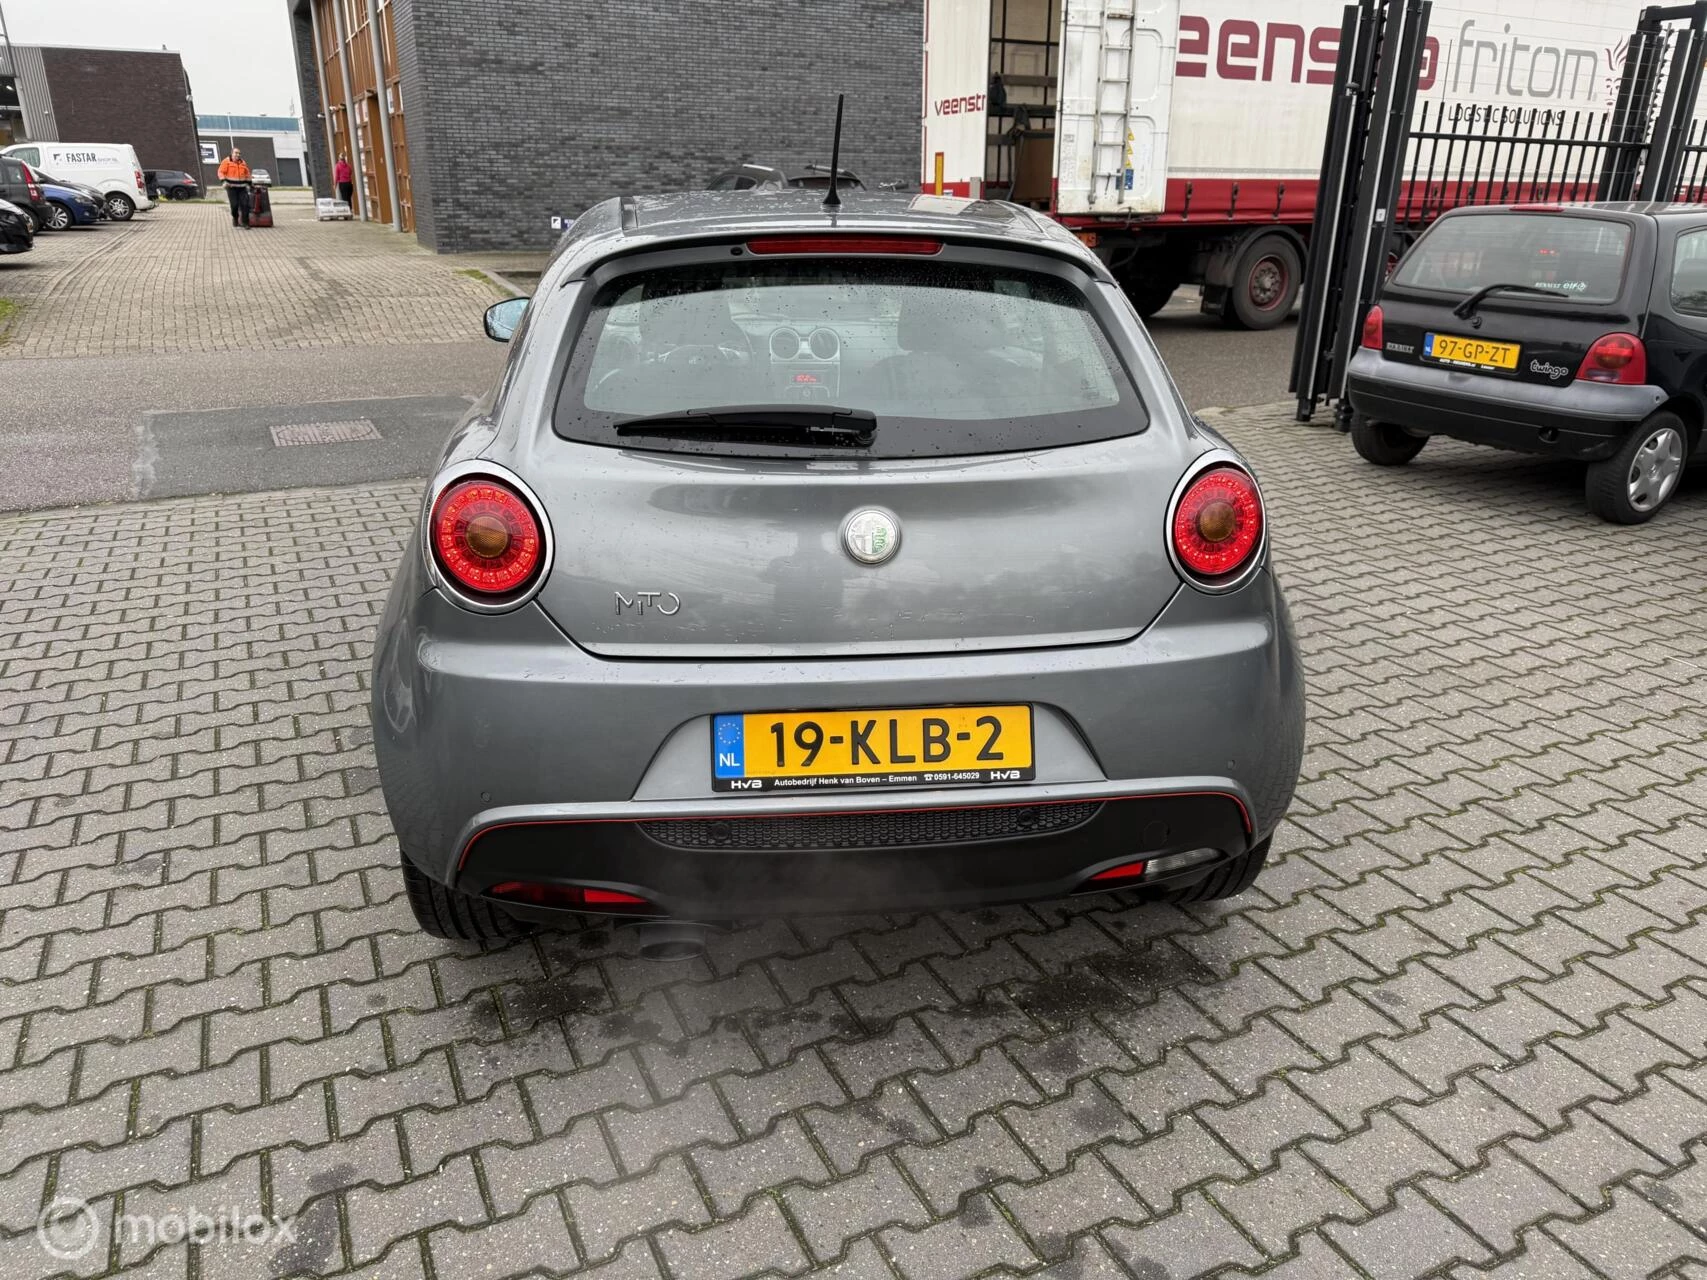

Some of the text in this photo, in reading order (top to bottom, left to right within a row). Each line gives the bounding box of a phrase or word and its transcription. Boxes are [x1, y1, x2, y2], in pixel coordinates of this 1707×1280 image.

[1452, 19, 1598, 101] fritom
[1448, 105, 1500, 124] LOGSTC
[65, 152, 97, 163] FASTAR
[1439, 339, 1511, 364] 97-GP-ZT
[770, 715, 1004, 767] 19-KLB-2
[719, 753, 740, 767] NL
[774, 778, 817, 787] Autobedrijf
[818, 777, 838, 785] Henk
[856, 776, 880, 784] Boven
[889, 775, 918, 783] Emmen
[934, 772, 980, 781] 0591-645029
